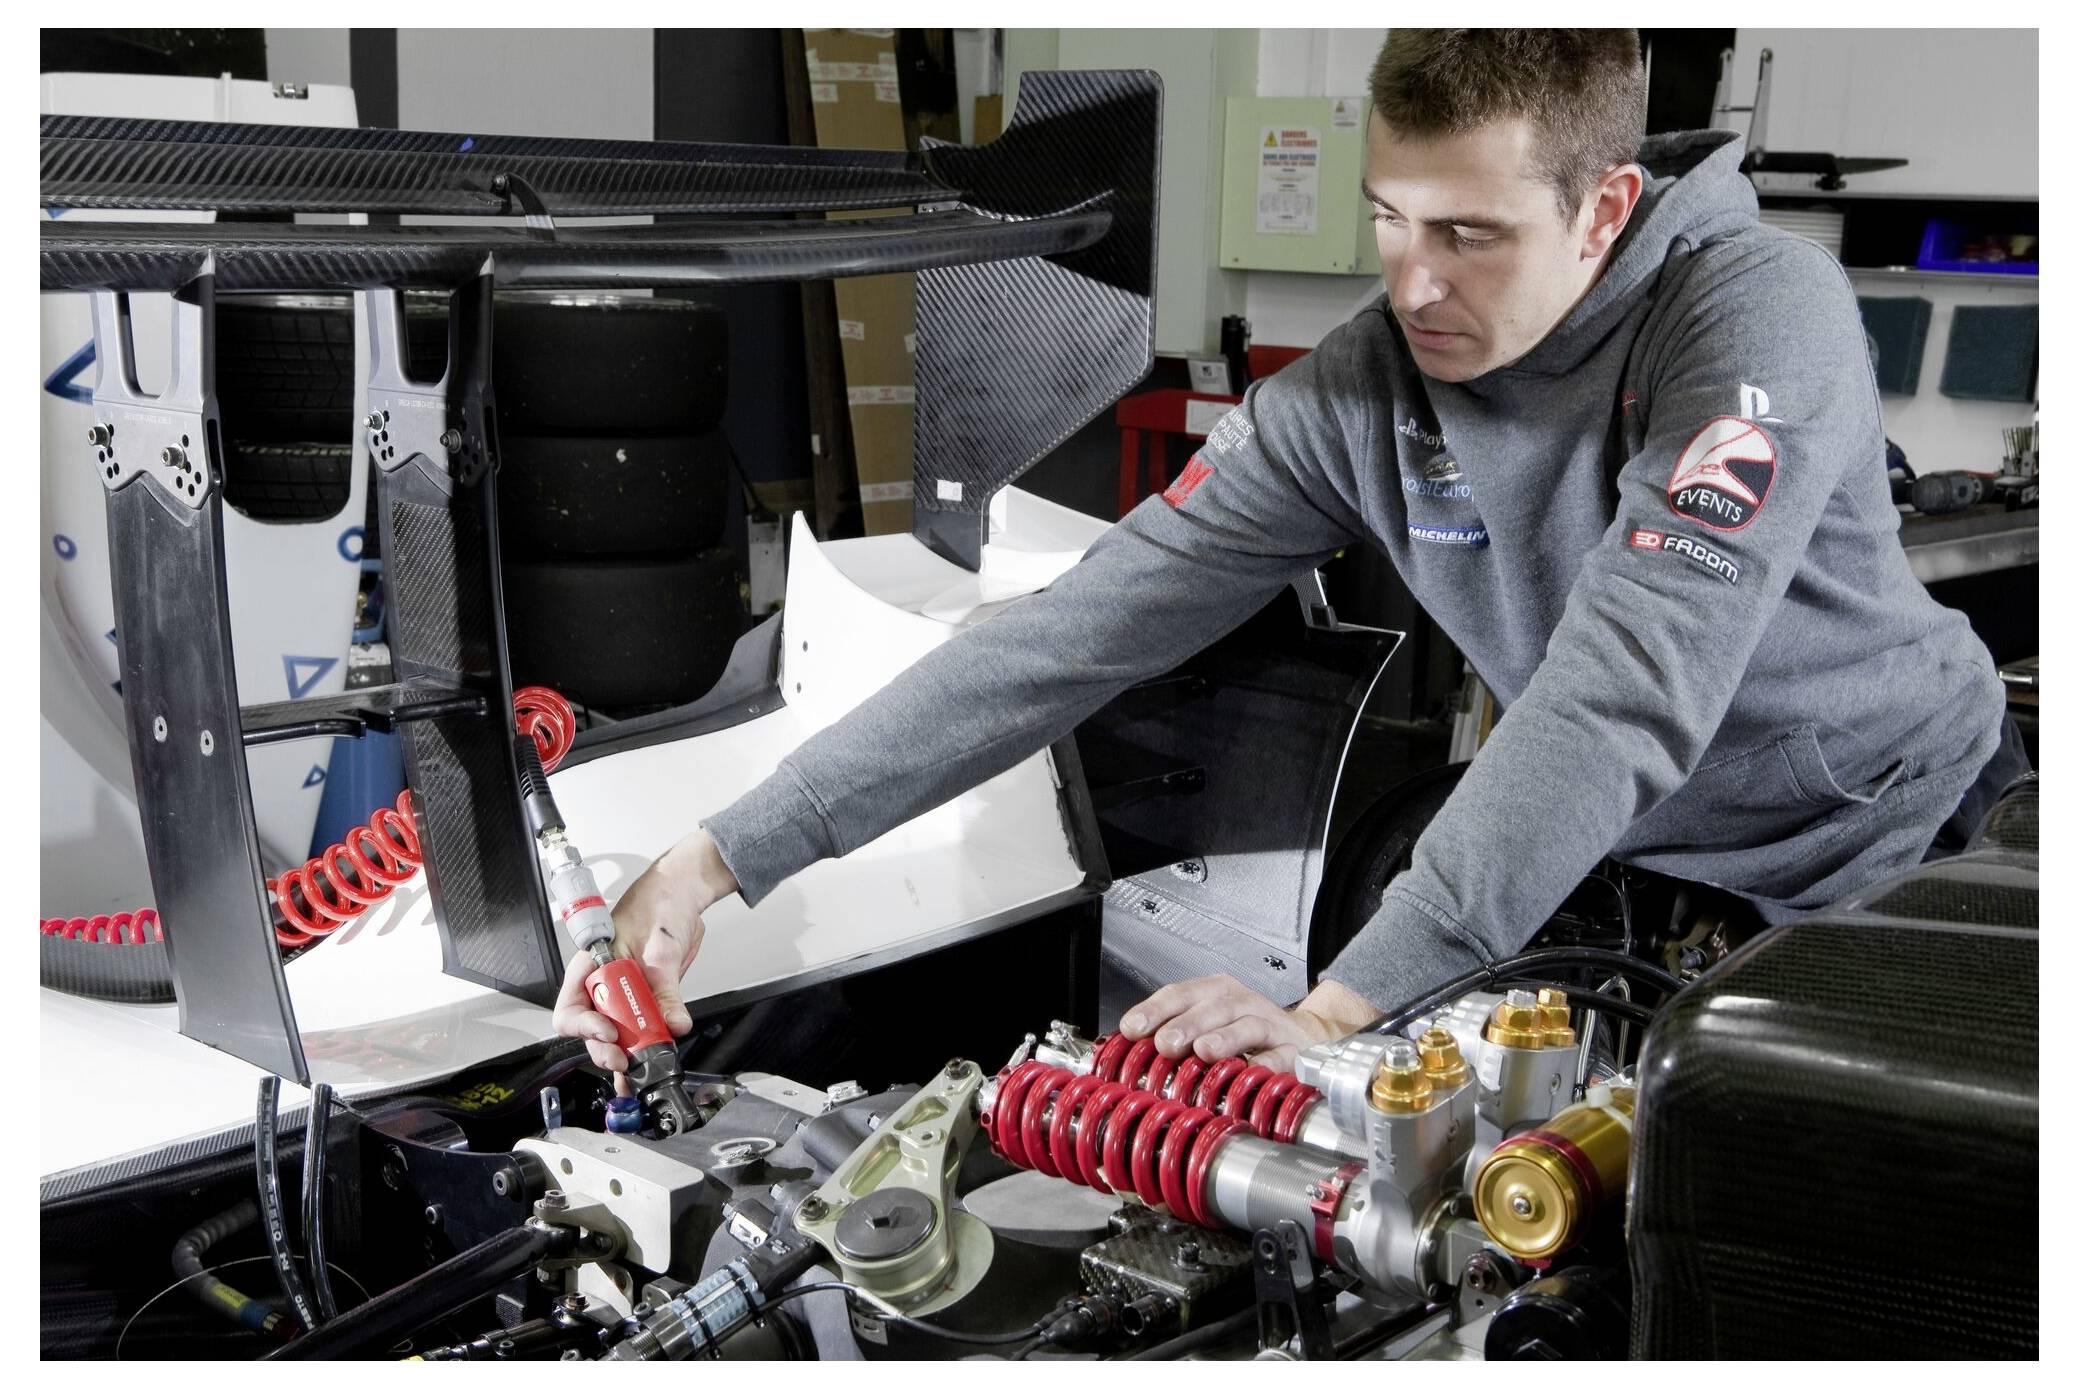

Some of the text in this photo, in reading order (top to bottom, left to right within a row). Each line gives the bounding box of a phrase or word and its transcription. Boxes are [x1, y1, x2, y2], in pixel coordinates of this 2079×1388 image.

[1676, 487, 1743, 523] EVENTS
[1408, 526, 1487, 541] MICHELIN
[1663, 536, 1738, 583] FACOM
